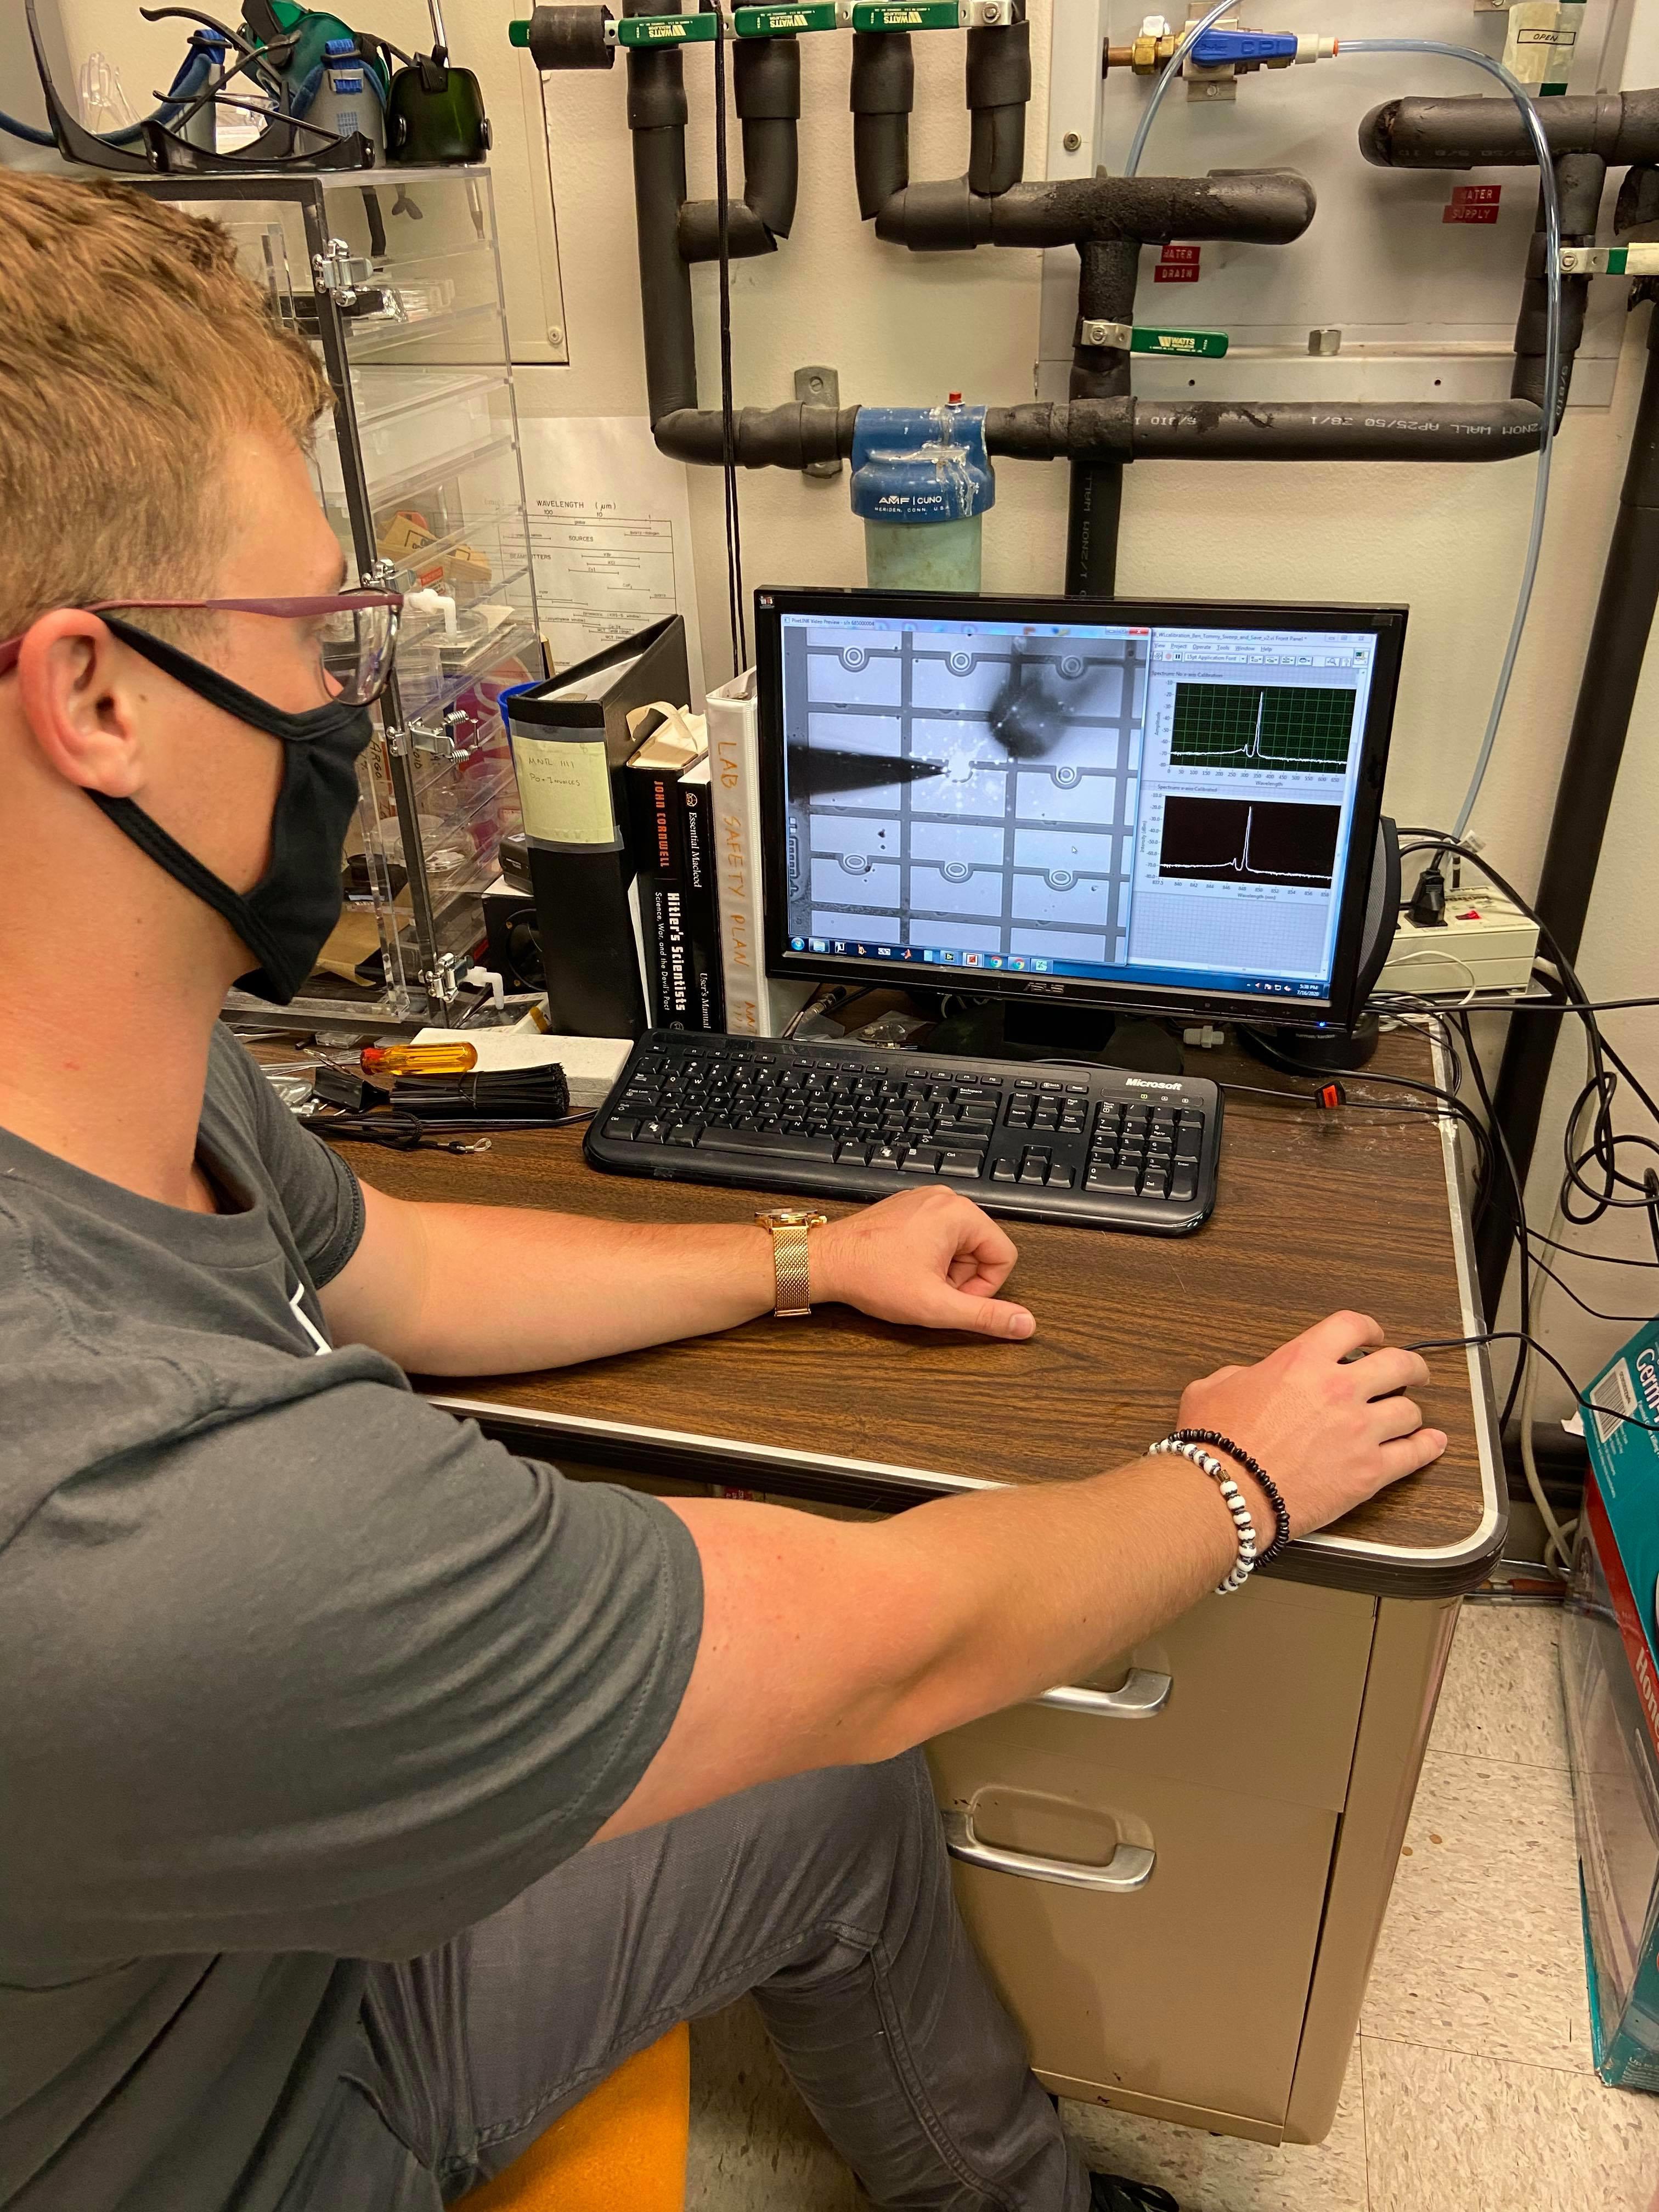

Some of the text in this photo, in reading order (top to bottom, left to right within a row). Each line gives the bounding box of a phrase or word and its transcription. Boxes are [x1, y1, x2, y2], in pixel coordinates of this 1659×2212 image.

[770, 19, 794, 28] WATTS
[884, 15, 910, 24] WATTS
[649, 30, 674, 38] WATTS
[1533, 33, 1559, 42] OPEN
[1452, 209, 1491, 218] SUPPLY
[1163, 249, 1192, 259] WATER
[1162, 268, 1193, 278] DRAIN
[1365, 417, 1440, 431] AP25/50
[1451, 424, 1491, 435] WALL
[537, 500, 584, 509] WAVELENGTH
[879, 495, 943, 505] AMF CUNO
[1255, 780, 1283, 788] Wavelength
[653, 781, 669, 867] JOHN CORNWELL
[689, 811, 702, 888] Essential Macleod
[718, 742, 750, 967] LAB SAFETY PLAN
[667, 893, 687, 1011] Hitler's Scientists
[662, 972, 670, 994] Devil's
[1023, 983, 1064, 994] ASUS
[700, 973, 712, 1029] User's Manual
[1125, 1078, 1182, 1090] Microsoft
